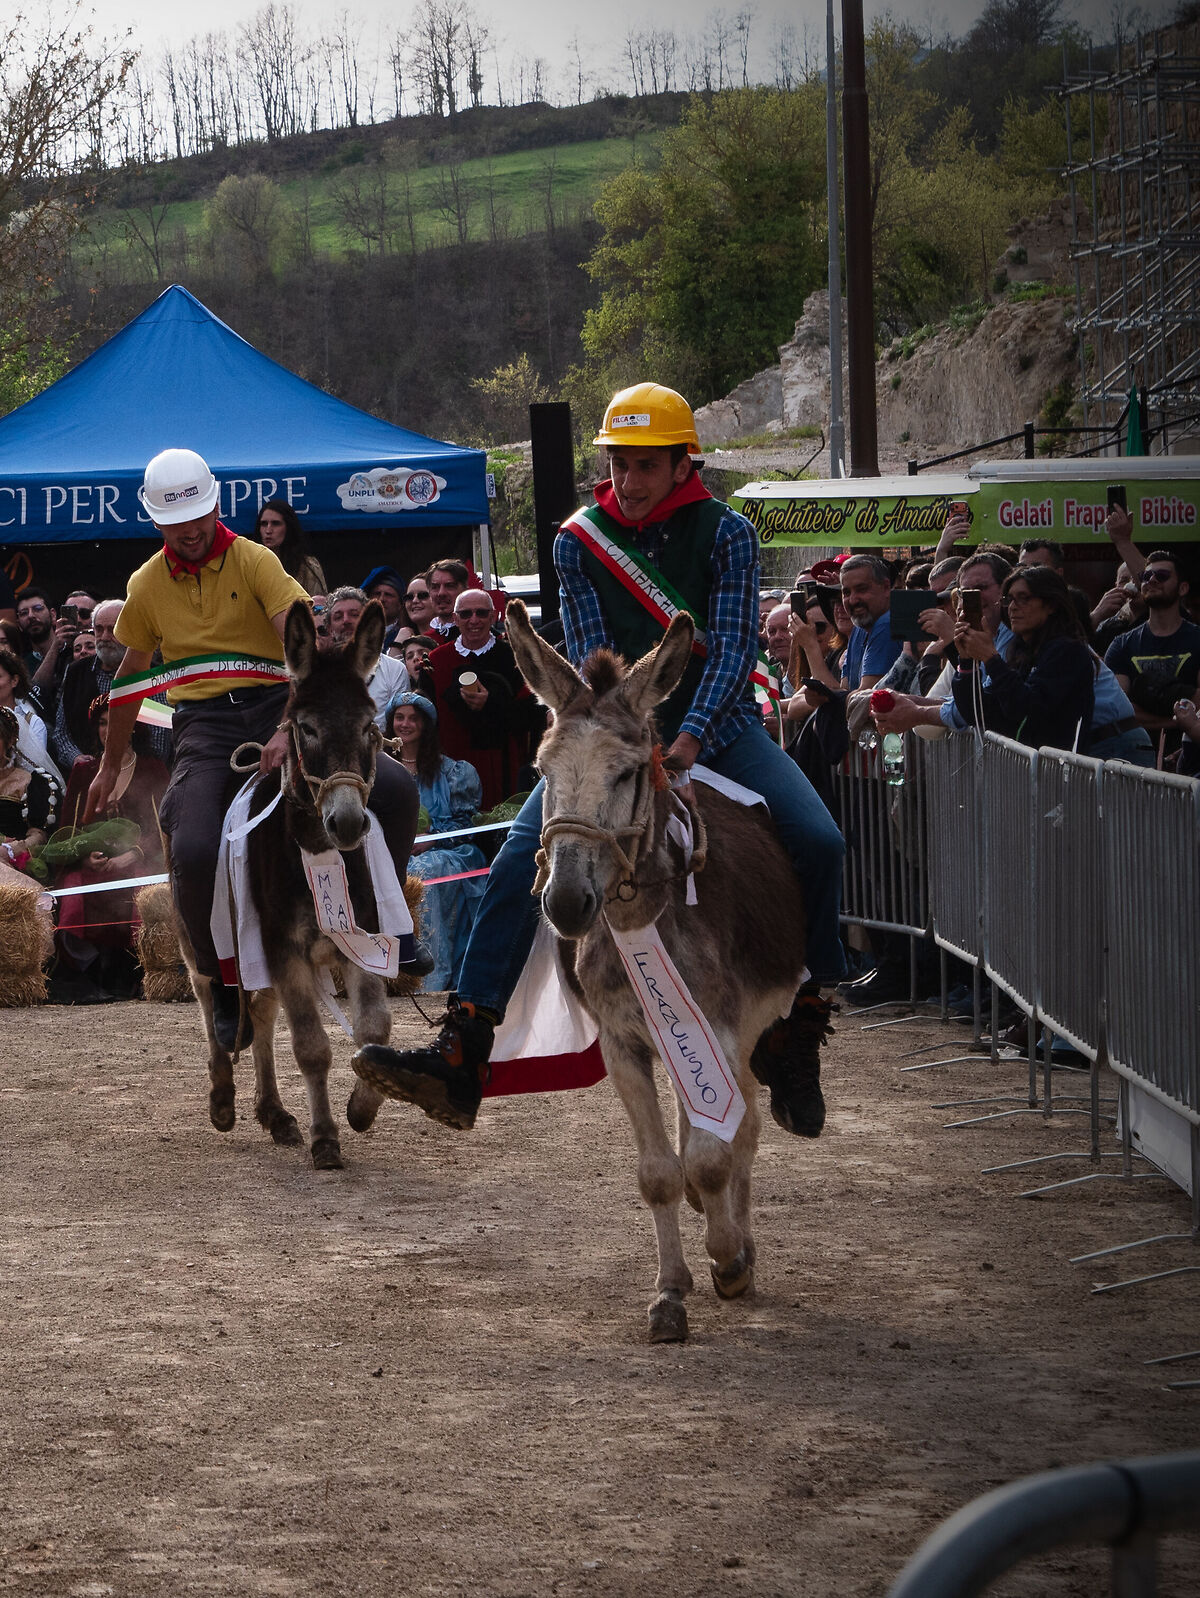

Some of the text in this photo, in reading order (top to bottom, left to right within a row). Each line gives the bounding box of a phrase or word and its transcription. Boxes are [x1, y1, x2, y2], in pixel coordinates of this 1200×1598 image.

[612, 416, 629, 424] FILCA
[41, 485, 128, 525] PER
[135, 479, 308, 522] SPRE
[348, 489, 375, 498] UNPLI
[856, 499, 879, 532] di
[878, 497, 972, 536] Amatri
[999, 498, 1196, 532] Gelati Frap Bibite
